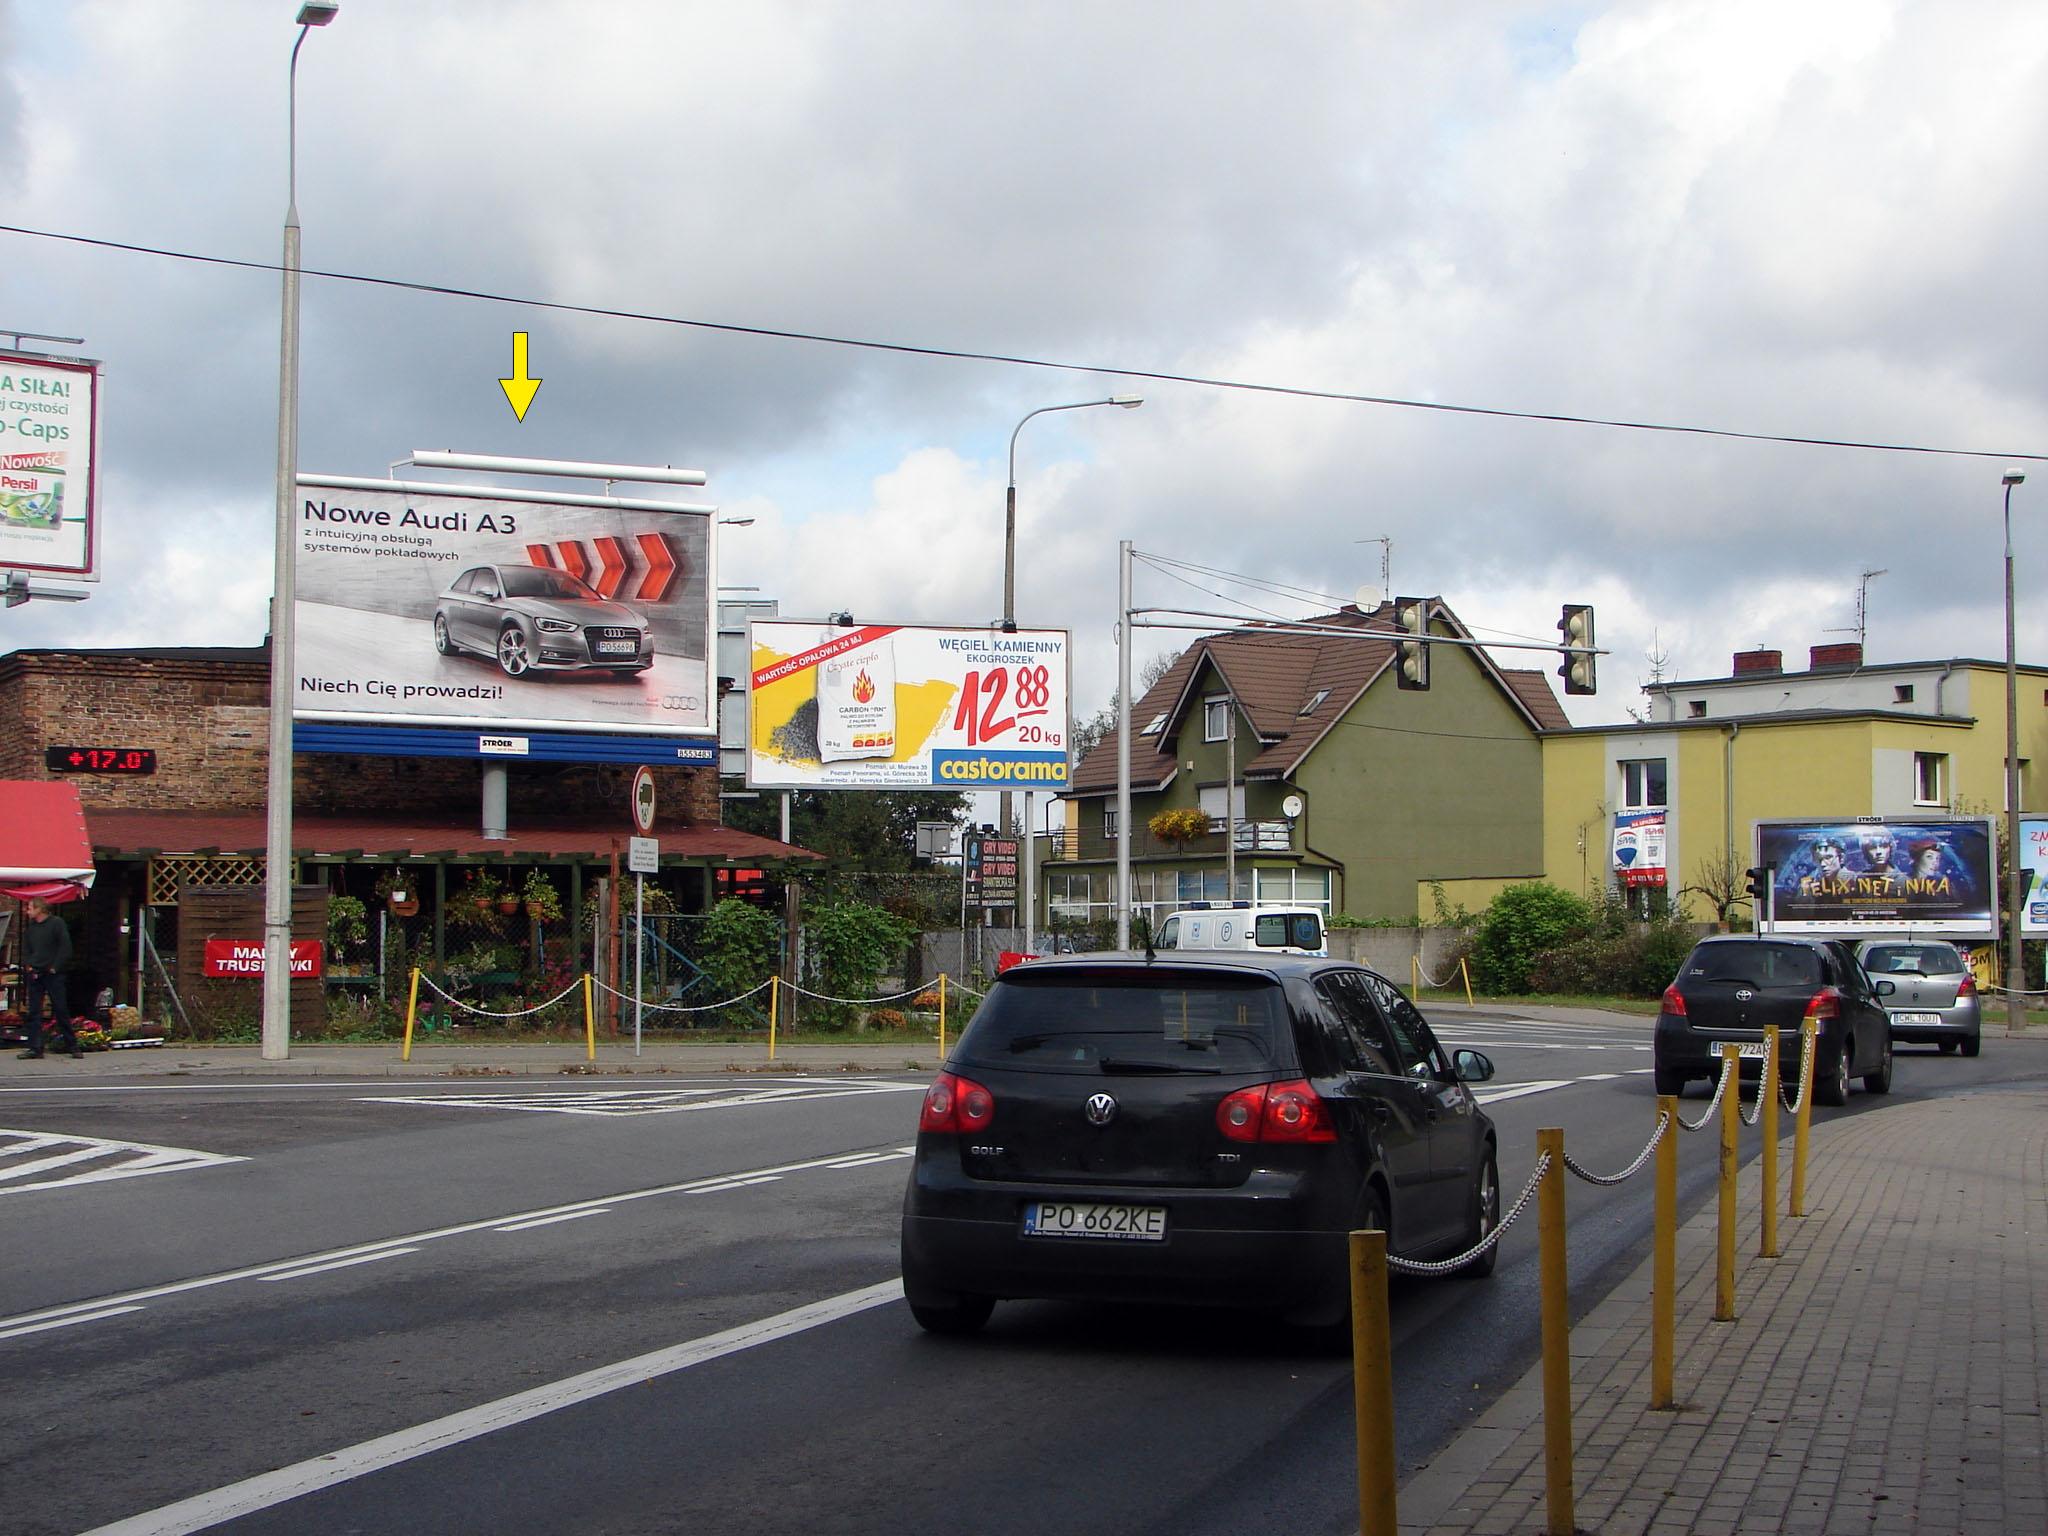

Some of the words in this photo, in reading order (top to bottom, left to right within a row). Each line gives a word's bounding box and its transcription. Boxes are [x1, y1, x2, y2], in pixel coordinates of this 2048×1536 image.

[20, 377, 70, 398] SIŁA!
[9, 399, 69, 416] czystości
[1, 476, 38, 491] Persil
[305, 500, 391, 526] Nowe
[399, 508, 467, 532] Audi
[476, 514, 516, 535] A3
[315, 528, 378, 544] intuicyjną
[382, 533, 433, 547] obsługą
[304, 543, 371, 555] systemów
[375, 546, 459, 561] pokładowych
[939, 638, 989, 653] WĘGIEL
[994, 640, 1061, 653] KAMIENNY
[757, 660, 798, 684] WARTOŚĆ
[798, 643, 839, 666] OPAŁOWA
[839, 640, 850, 650] 24
[849, 634, 863, 646] MJ
[966, 654, 1034, 664] EKOGROSZEK
[301, 677, 359, 694] Niech
[366, 680, 397, 699] Cię
[404, 683, 503, 700] prowadzi!
[954, 667, 1016, 747] 12
[1015, 665, 1050, 708] 88
[1018, 725, 1042, 743] 20
[1045, 731, 1061, 746] kg
[940, 757, 1067, 781] castorama
[998, 841, 1016, 855] VIDEO
[997, 863, 1016, 876] VIDEO
[1858, 876, 1894, 897] NET
[1905, 875, 1950, 897] NIKA
[233, 947, 298, 959] MAY
[216, 959, 312, 971] TRUSWKI
[971, 1146, 1004, 1156] GOLF
[1217, 1153, 1241, 1163] TDI
[1040, 1204, 1075, 1229] PO
[1084, 1206, 1162, 1233] 662KE
